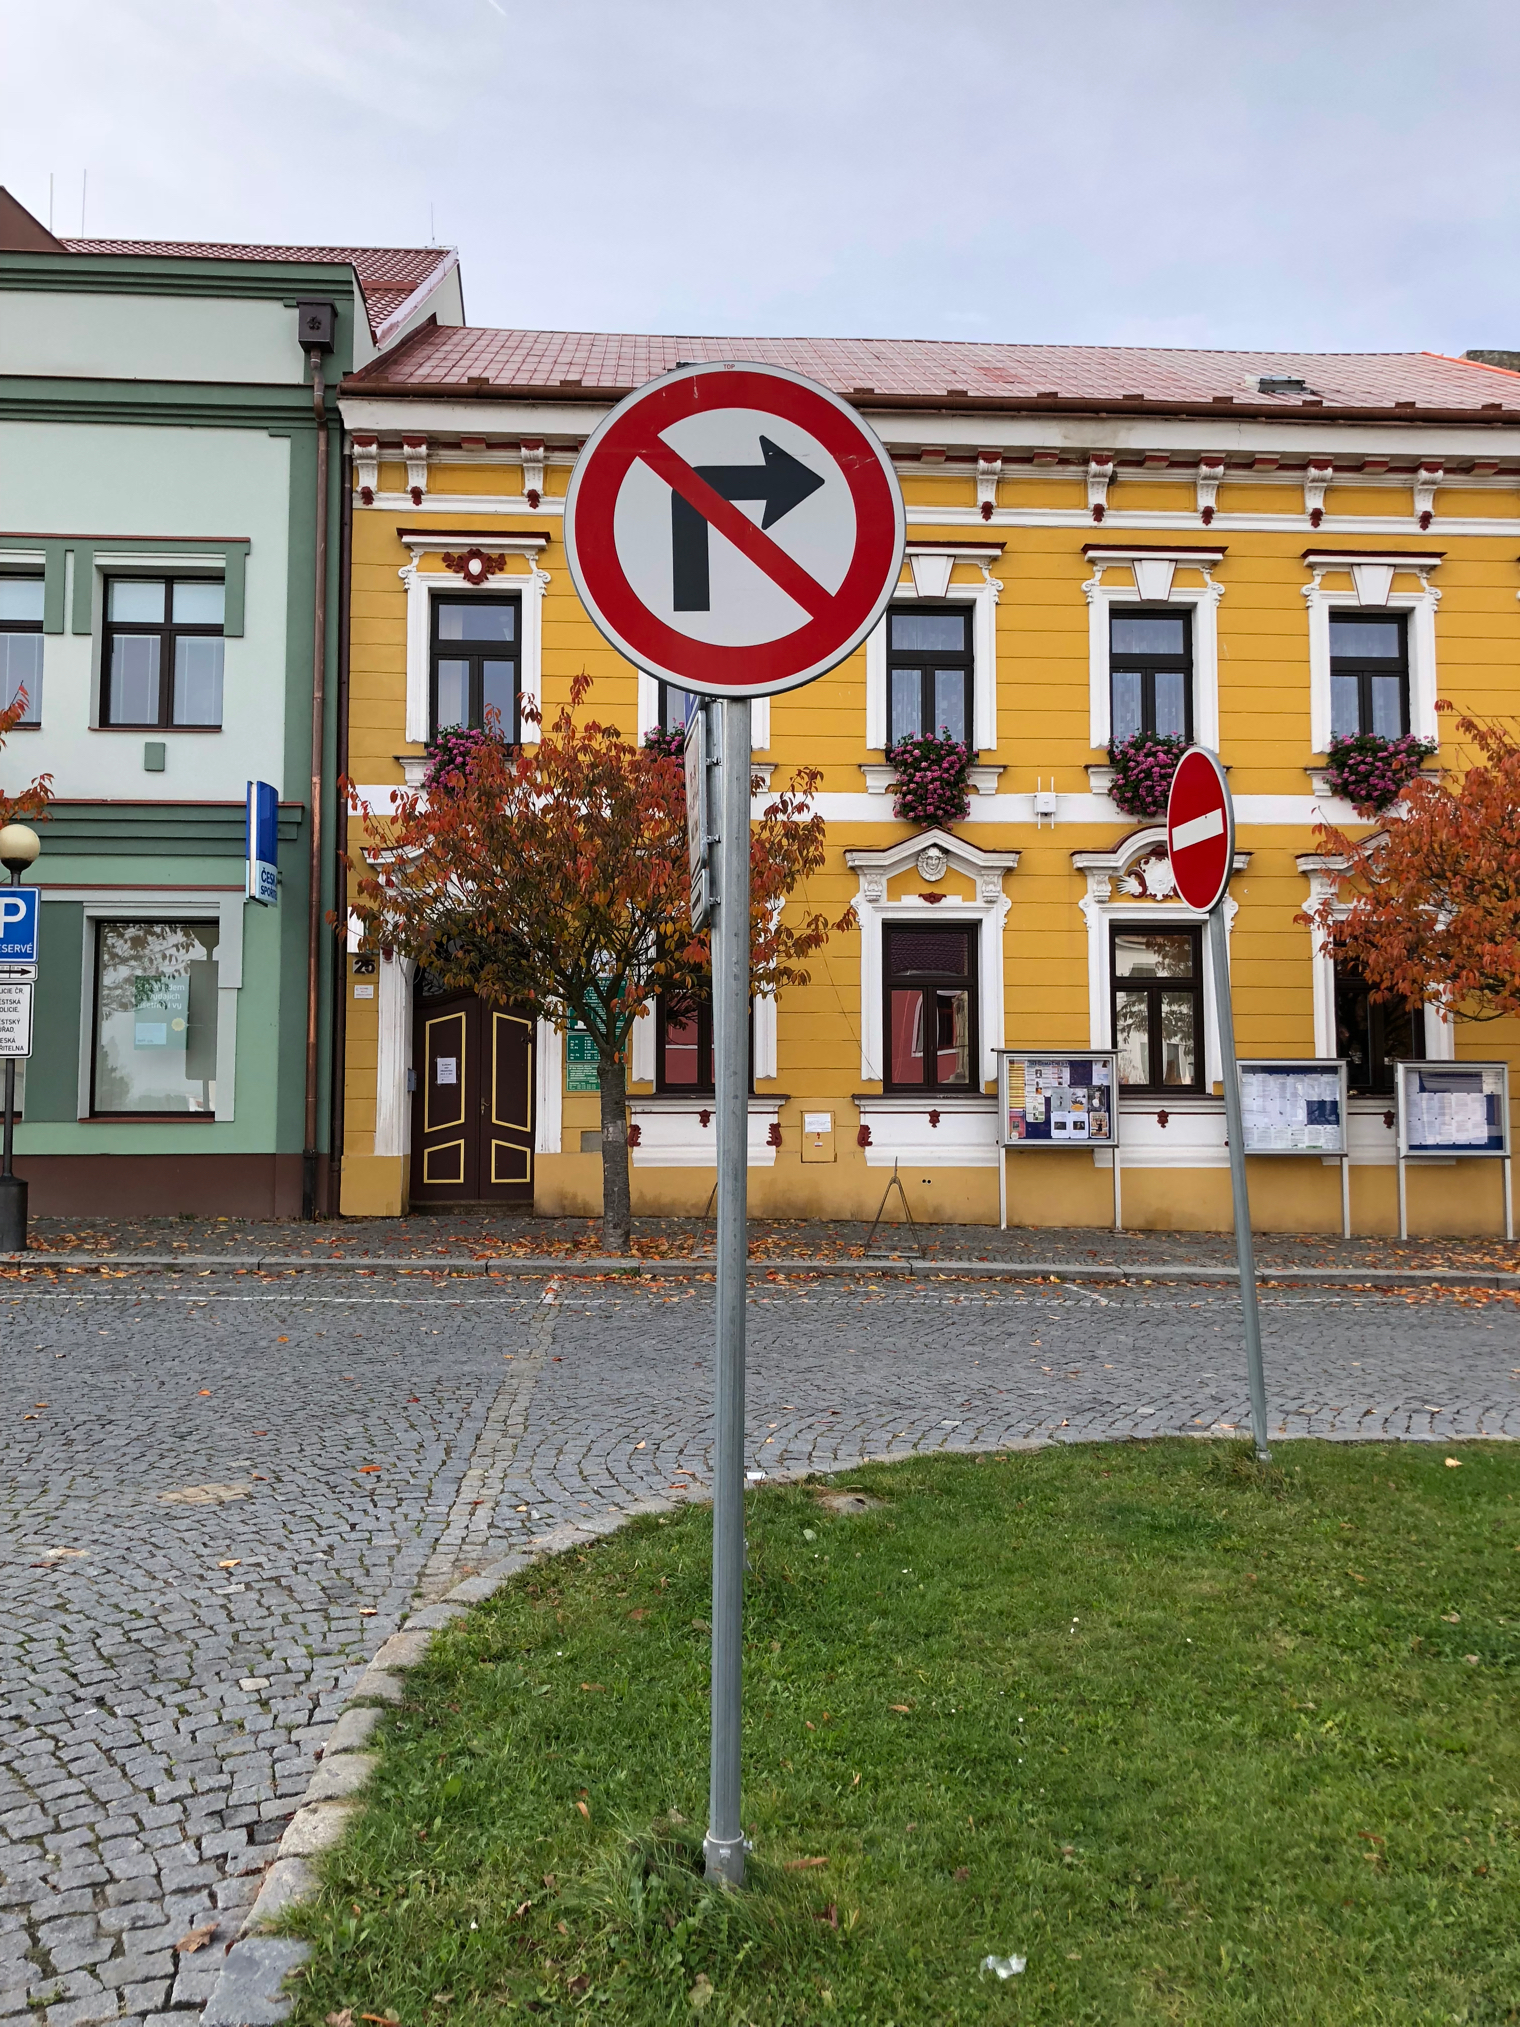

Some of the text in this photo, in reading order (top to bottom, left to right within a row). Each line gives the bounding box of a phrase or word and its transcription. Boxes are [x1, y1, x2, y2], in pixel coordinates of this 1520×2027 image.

[0, 897, 27, 938] P
[0, 942, 33, 954] SERVÉ
[354, 959, 376, 974] 25
[0, 997, 22, 1006] STSKÁ
[0, 1017, 21, 1026] STSKÝ
[0, 1025, 16, 1034] ŘAD,
